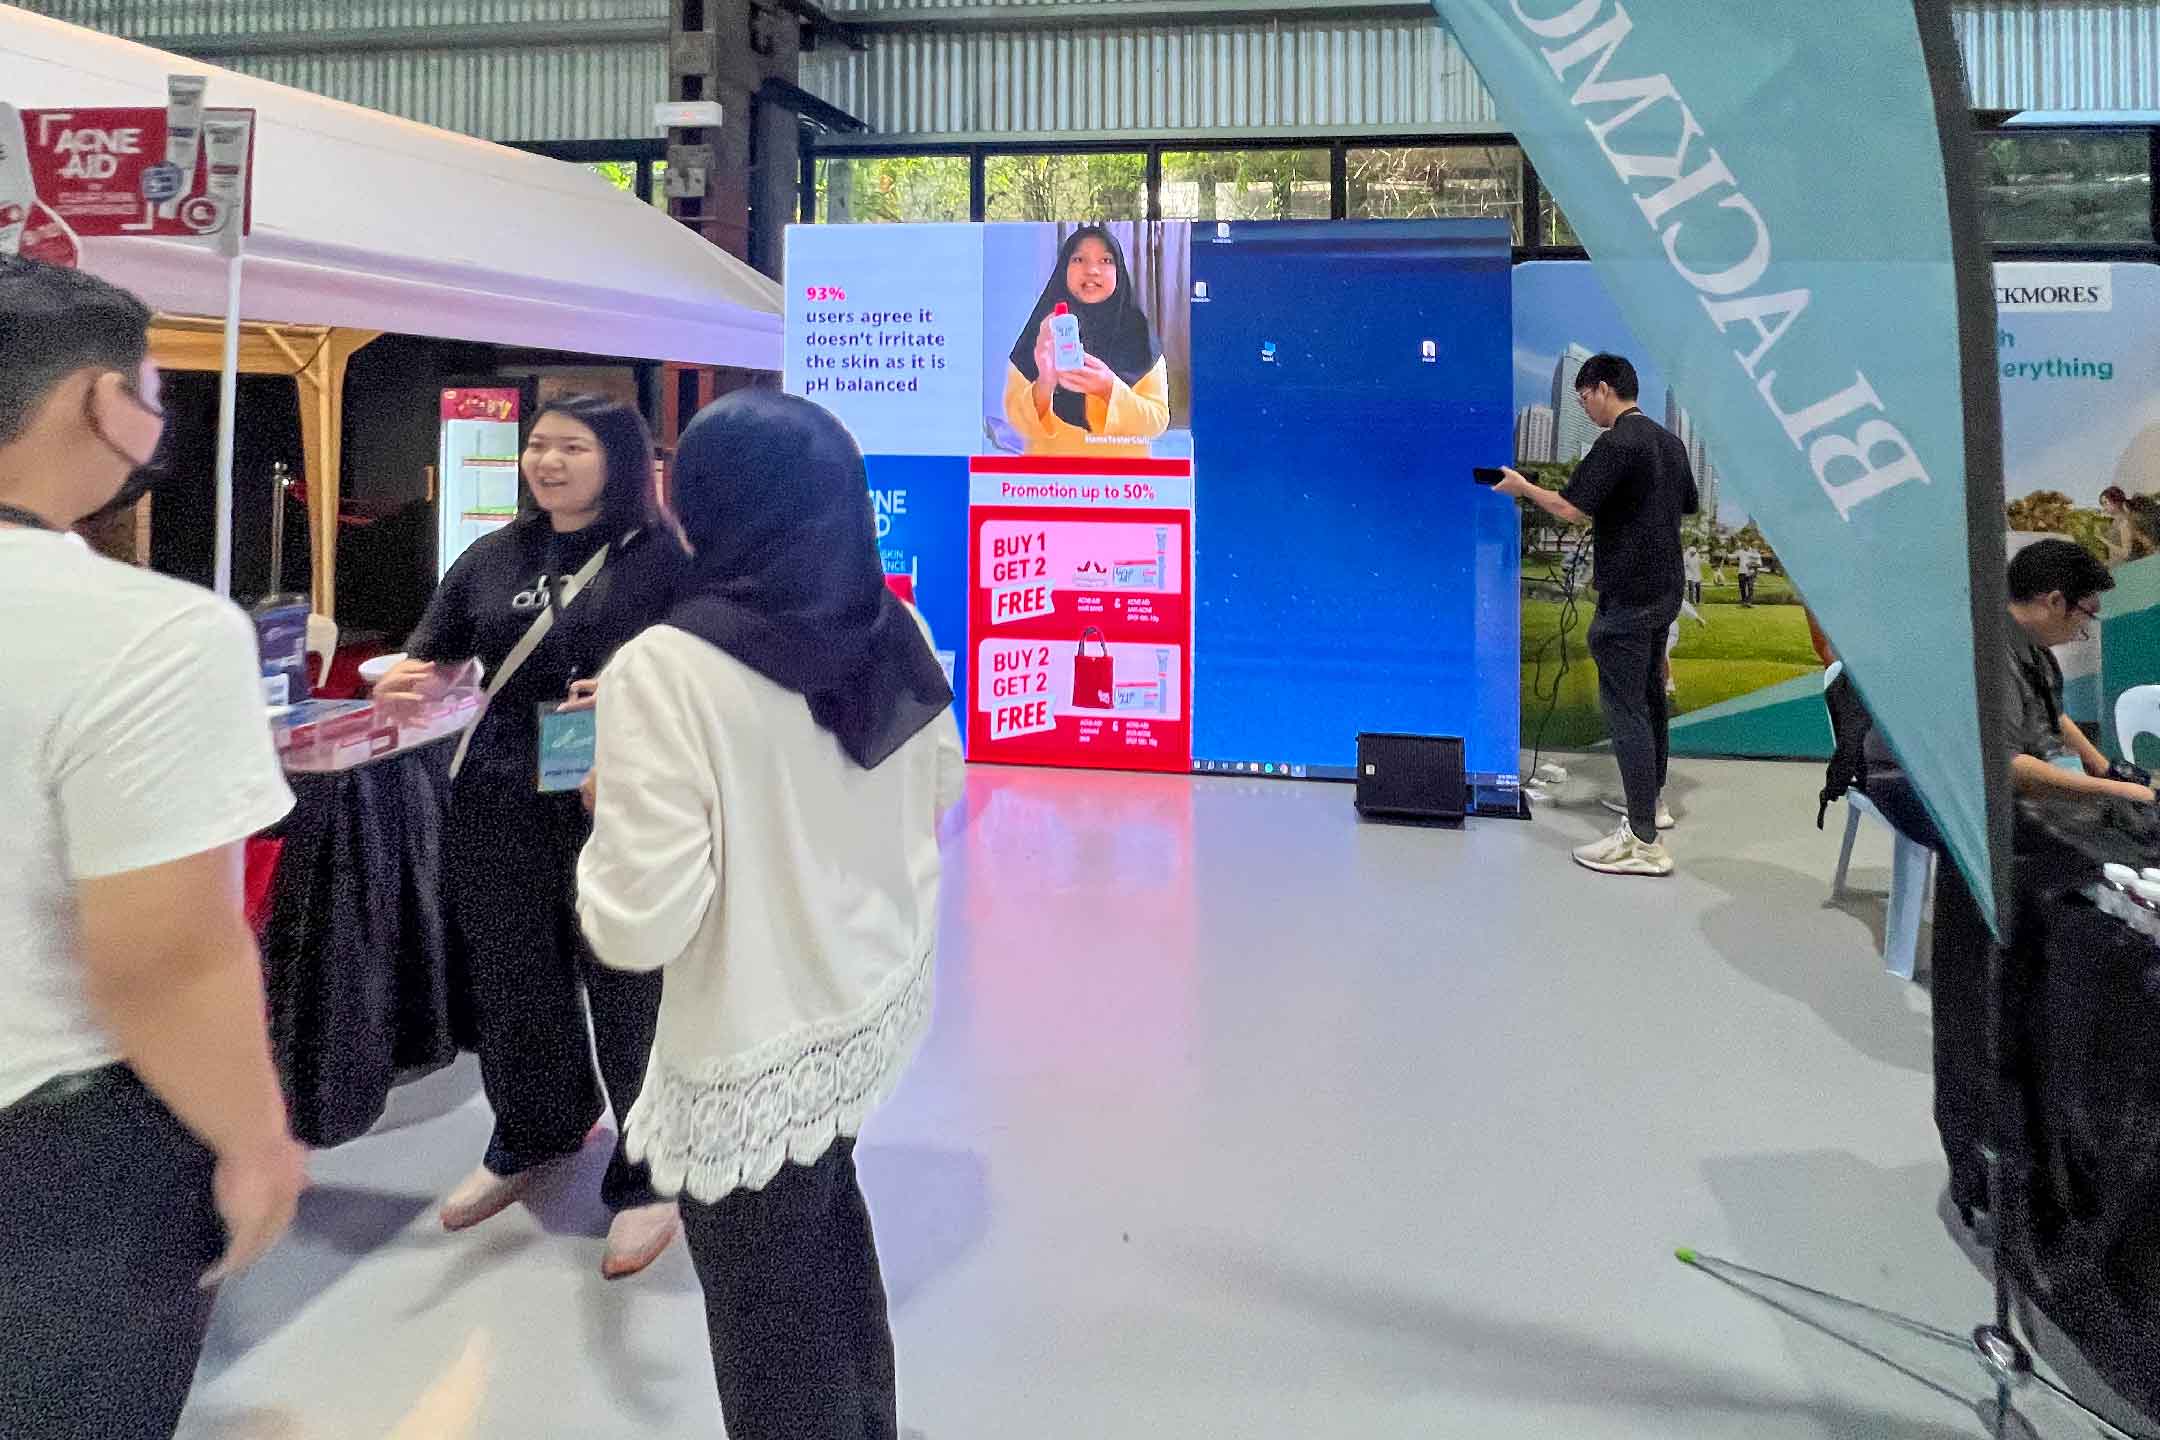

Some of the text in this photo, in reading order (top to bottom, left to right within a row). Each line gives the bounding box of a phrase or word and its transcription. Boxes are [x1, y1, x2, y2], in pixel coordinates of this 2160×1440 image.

[54, 128, 143, 154] ACNE
[58, 154, 119, 178] AID
[807, 287, 846, 301] 93%
[806, 308, 933, 327] users agree it
[806, 331, 945, 346] doesn't irritate
[806, 353, 945, 369] the skin as it is
[2003, 358, 2113, 380] erything
[806, 377, 918, 395] pH balanced
[870, 489, 907, 514] NE
[1001, 482, 1155, 502] Promotion up to 50%
[993, 532, 1046, 558] BUY 1
[993, 557, 1047, 582] GET 2
[997, 586, 1047, 617] FREE
[993, 646, 1049, 673] BUY 2
[993, 672, 1048, 697] GET 2
[997, 700, 1048, 734] FREE
